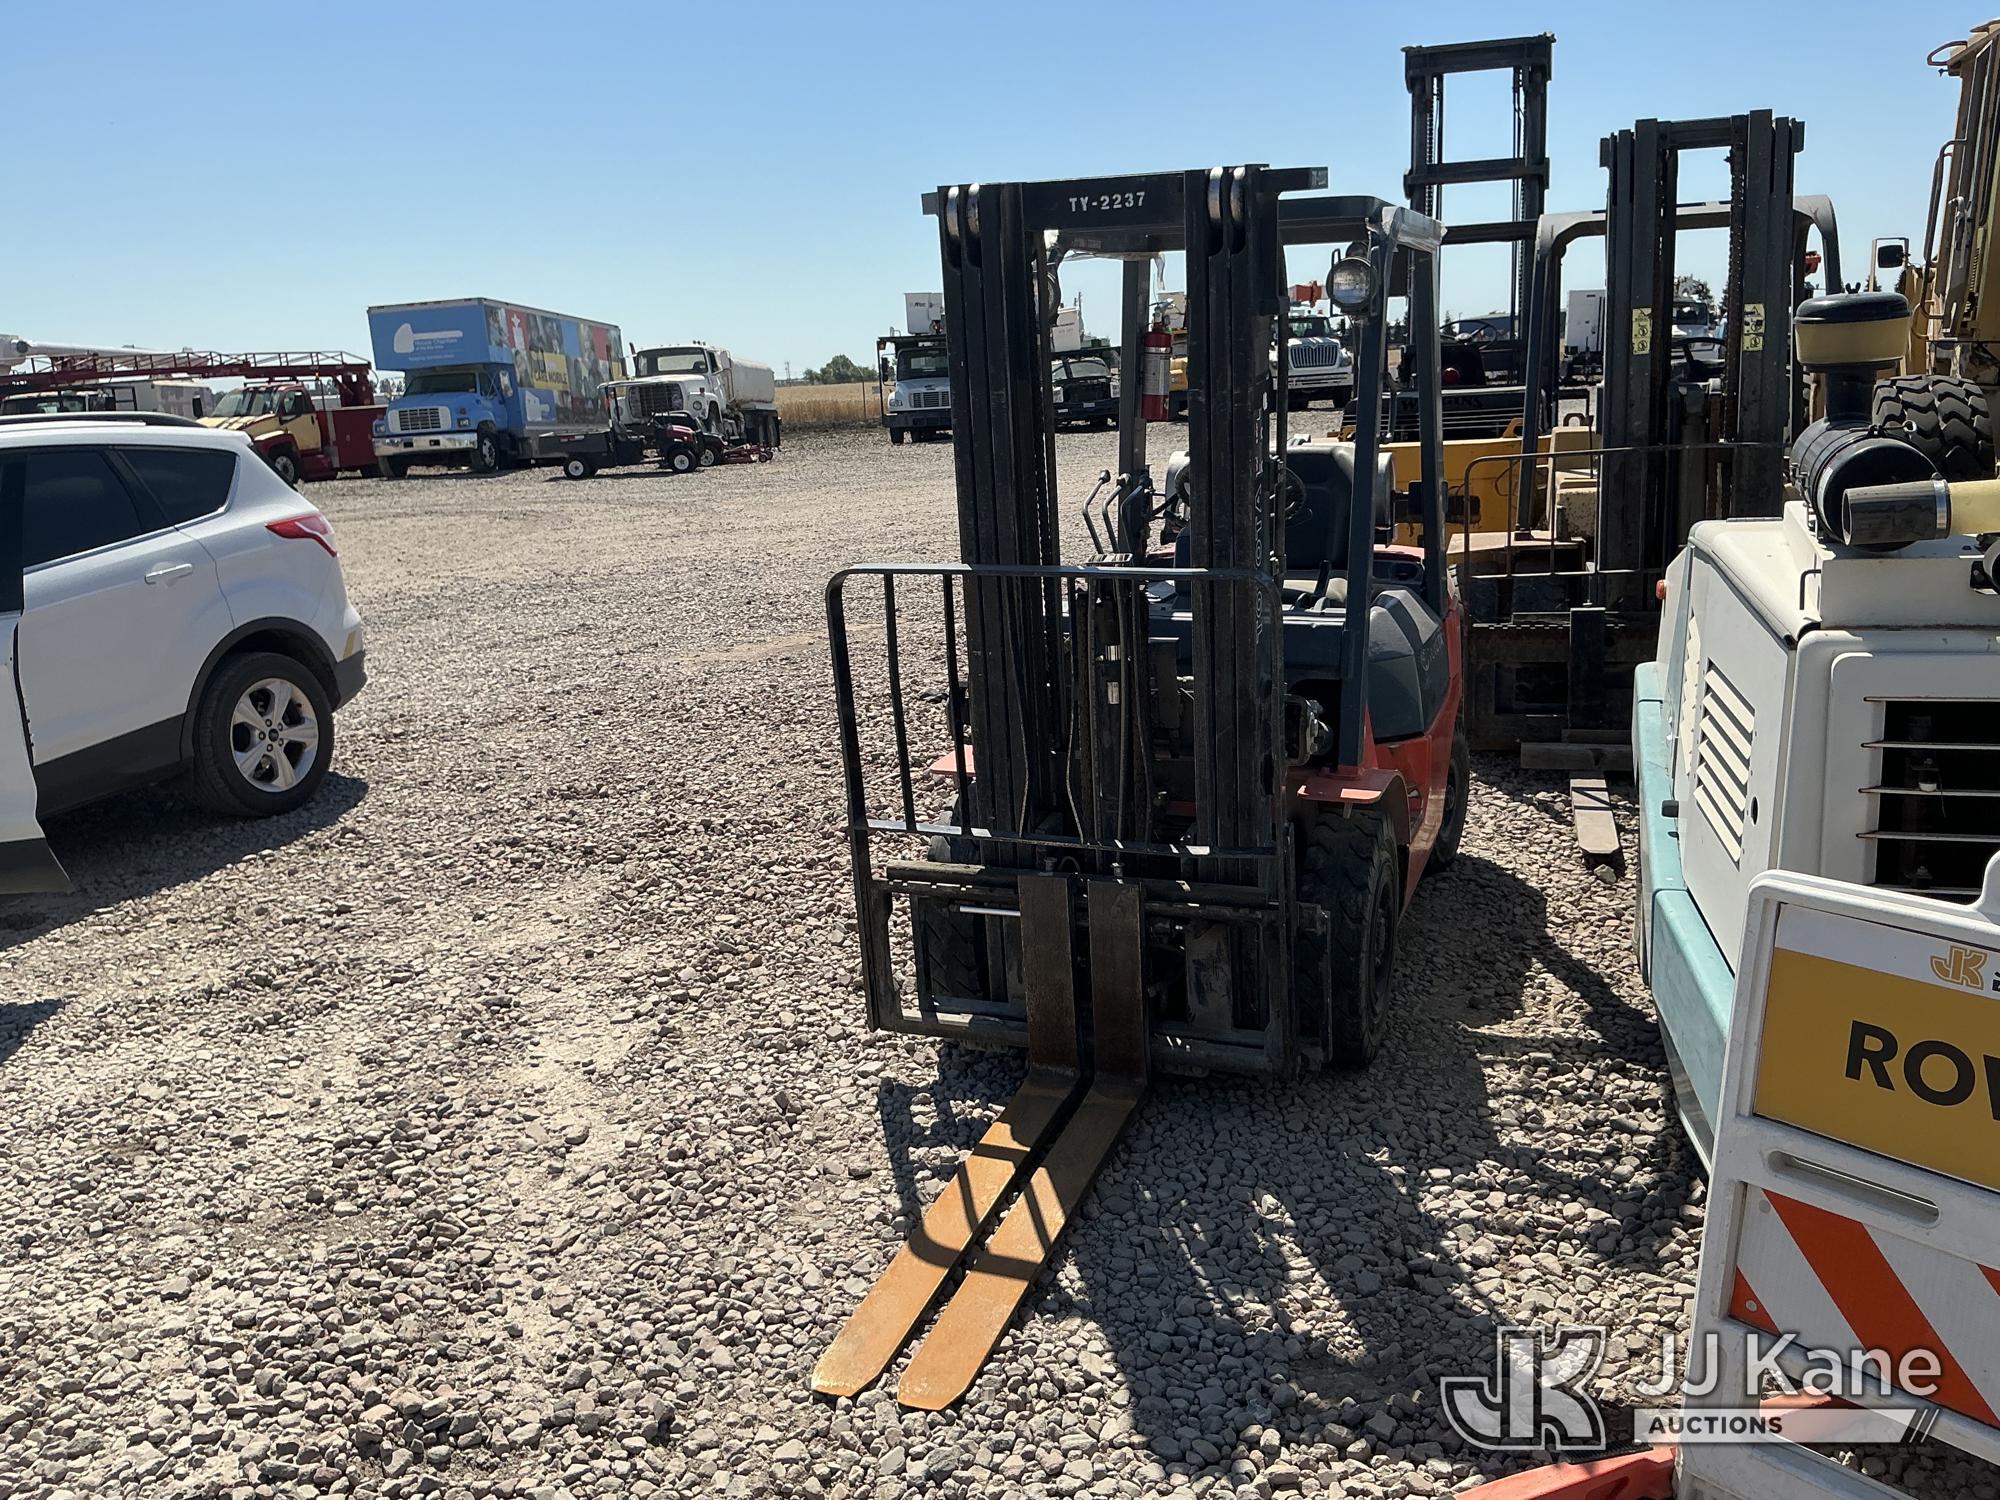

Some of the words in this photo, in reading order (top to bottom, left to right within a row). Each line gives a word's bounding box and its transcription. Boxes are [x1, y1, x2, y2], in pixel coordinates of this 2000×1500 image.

[1069, 191, 1145, 212] TY-2237
[1254, 484, 1264, 645] TOOTA
[1930, 945, 1988, 990] JK
